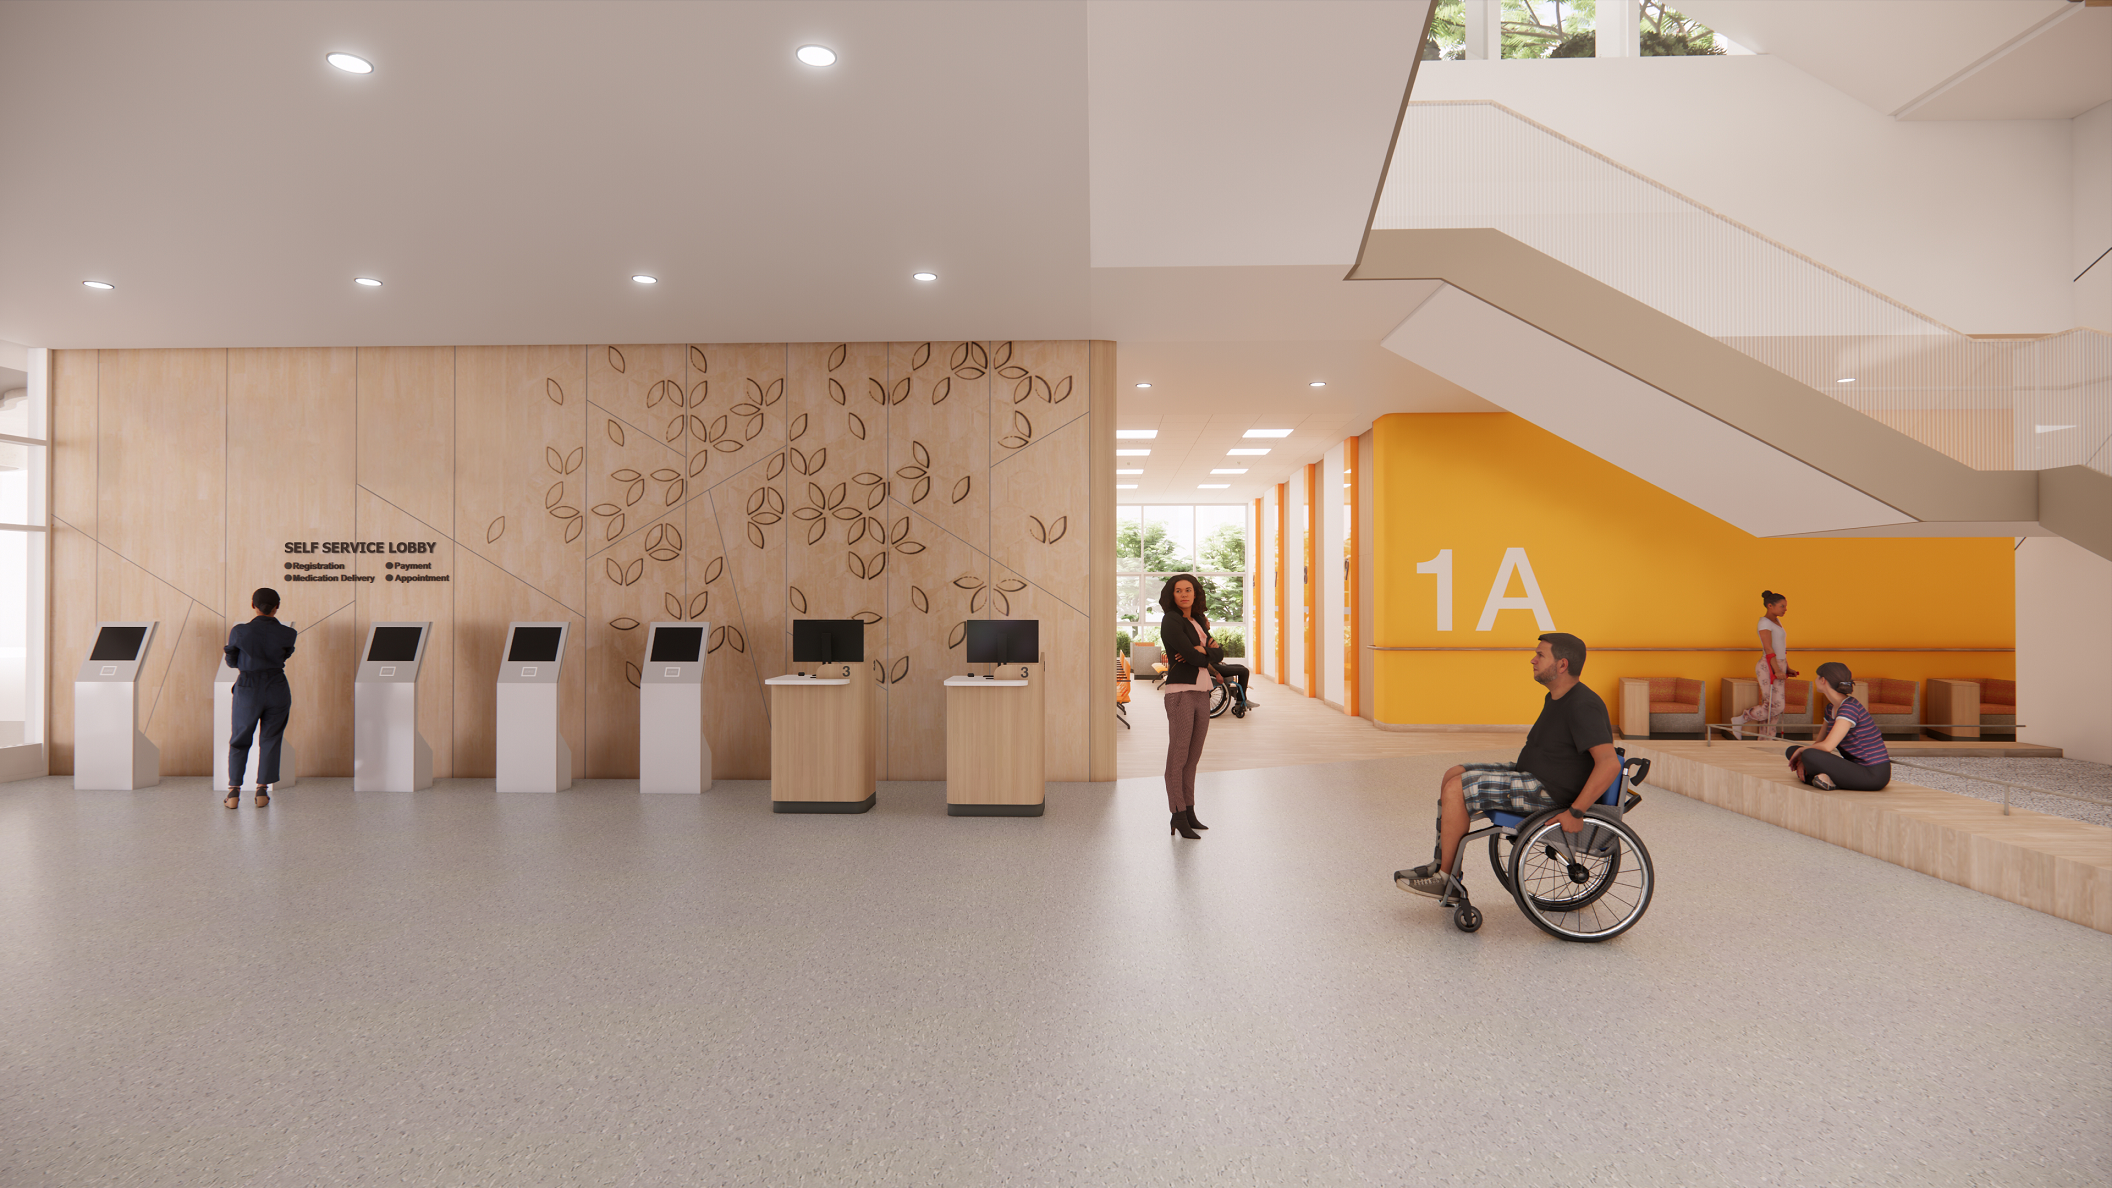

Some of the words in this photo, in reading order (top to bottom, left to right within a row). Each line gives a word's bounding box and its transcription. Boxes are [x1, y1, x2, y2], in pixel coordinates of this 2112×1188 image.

[284, 541, 319, 554] SELF
[322, 541, 385, 554] SERVICE
[388, 541, 437, 554] LOBBY
[293, 562, 345, 571] Registration
[394, 562, 432, 571] Payment
[293, 574, 339, 582] Medication
[340, 574, 376, 583] Delivery
[394, 574, 450, 583] Appointment
[1416, 547, 1557, 631] 1A
[842, 665, 851, 677] 3
[1020, 666, 1029, 679] 3
